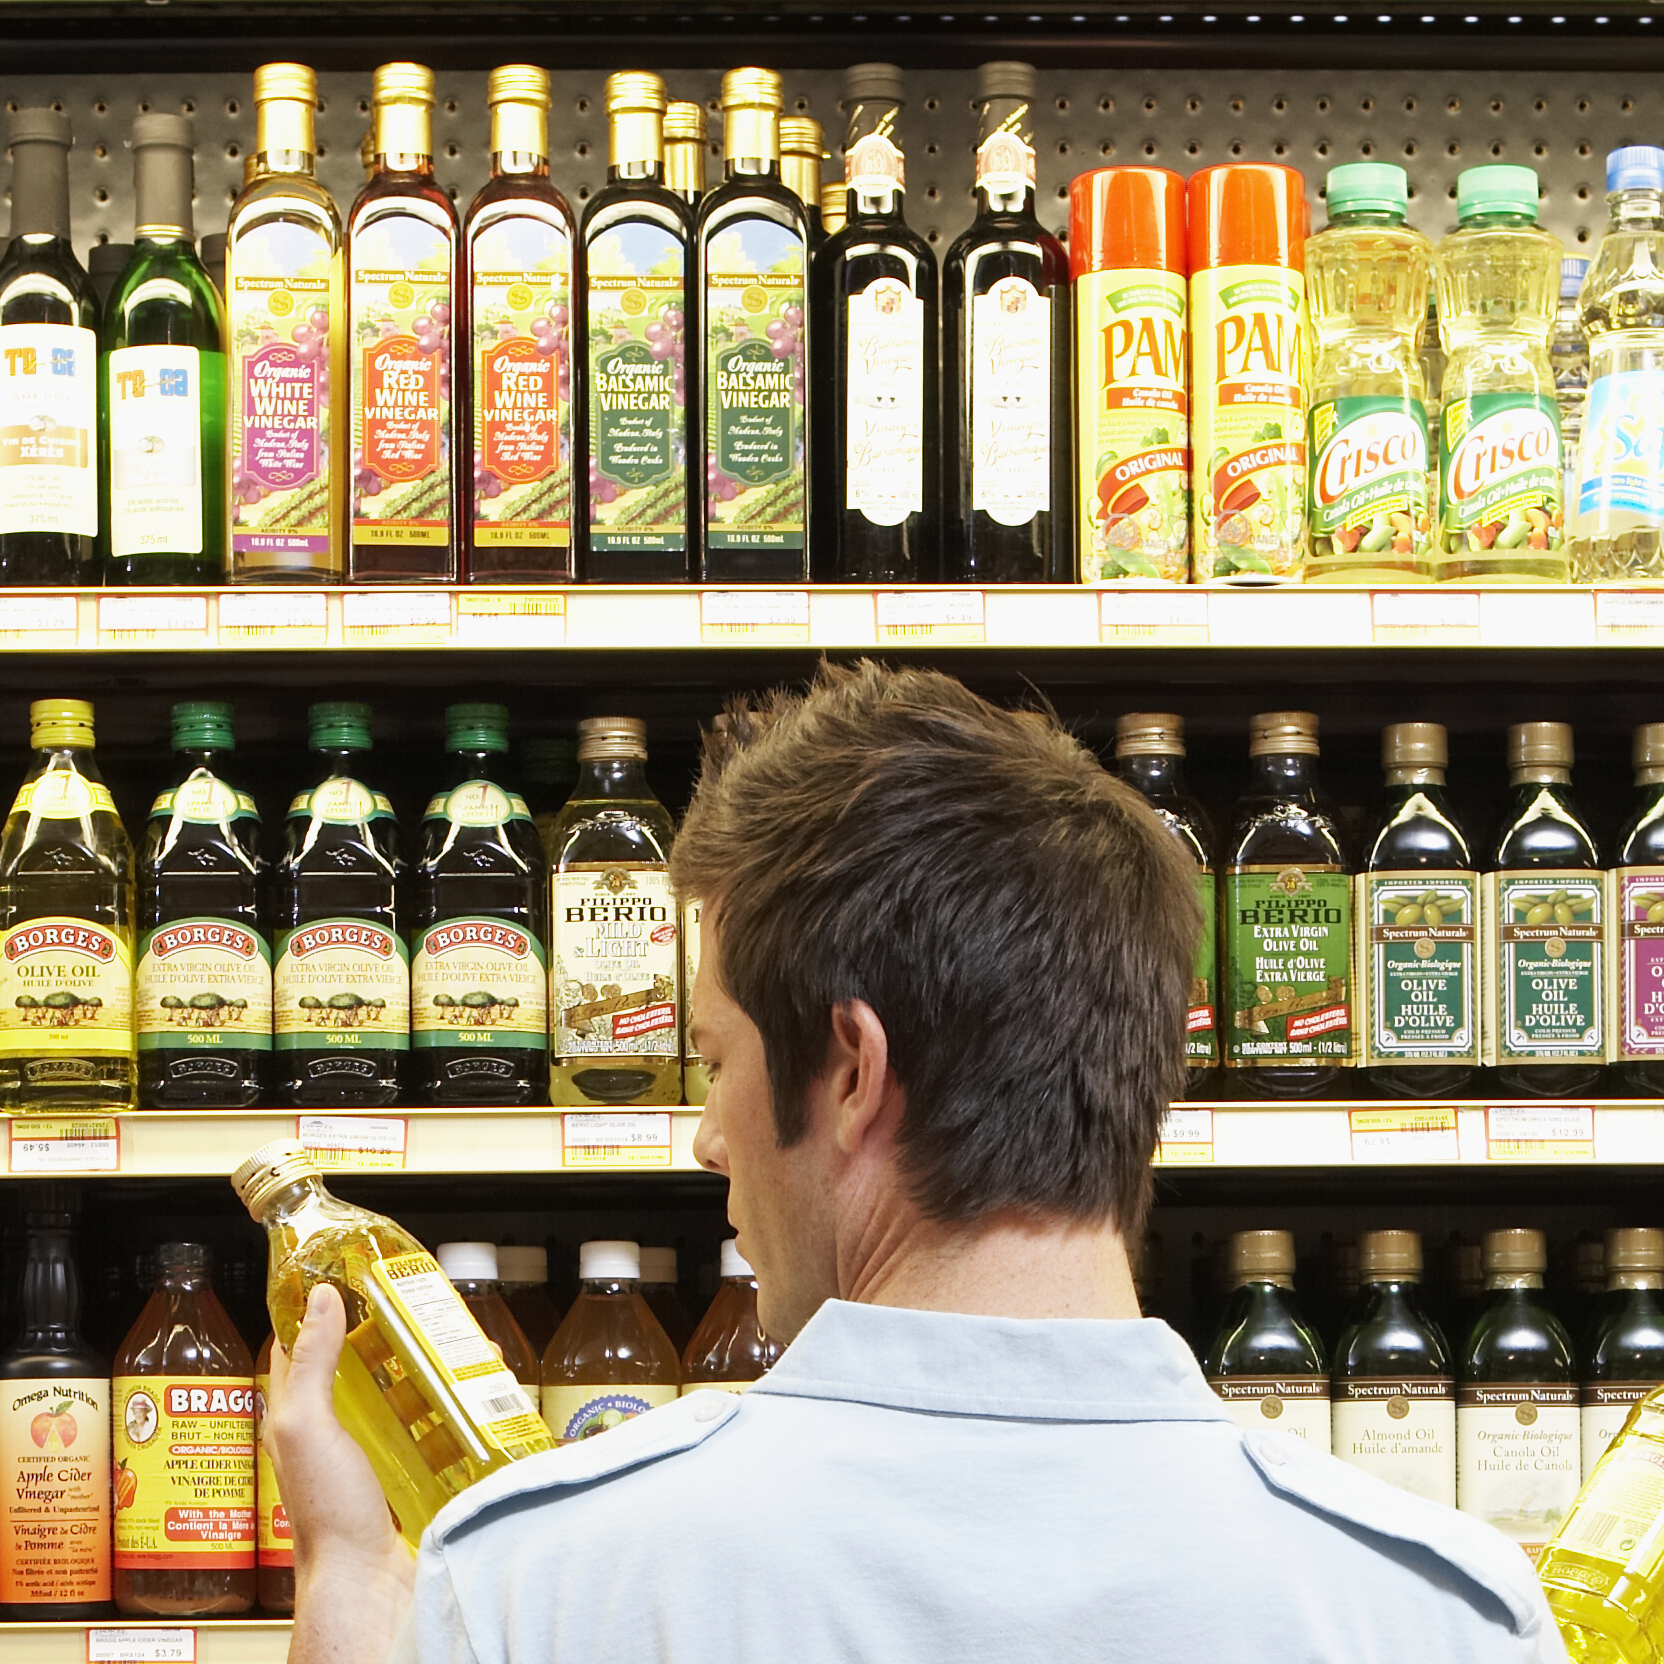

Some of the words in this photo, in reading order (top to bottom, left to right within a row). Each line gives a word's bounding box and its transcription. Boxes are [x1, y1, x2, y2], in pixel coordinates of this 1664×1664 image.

[254, 361, 312, 380] Organic
[250, 378, 313, 398] WHITE
[383, 372, 424, 389] RED
[717, 372, 794, 391] BALSAMIC
[254, 398, 309, 415] WINE
[721, 391, 790, 408] VINEGAR
[244, 414, 318, 430] VINEGAR
[1114, 449, 1185, 483] ORIGINAL
[580, 897, 652, 907] FILIPPO
[565, 907, 667, 922] BERIO
[595, 922, 643, 939] MILD
[435, 930, 518, 950] BORGES
[1401, 979, 1447, 992] OLIVE
[1410, 990, 1437, 1003] OIL
[458, 1032, 479, 1042] 500
[481, 1032, 494, 1042] ML
[631, 1134, 658, 1142] $8.99
[1551, 1128, 1584, 1137] $12.99
[170, 1388, 254, 1416] BRAGG
[1362, 1428, 1410, 1441] Almond
[1413, 1428, 1435, 1440] Oil
[155, 1649, 182, 1658] $3.79
